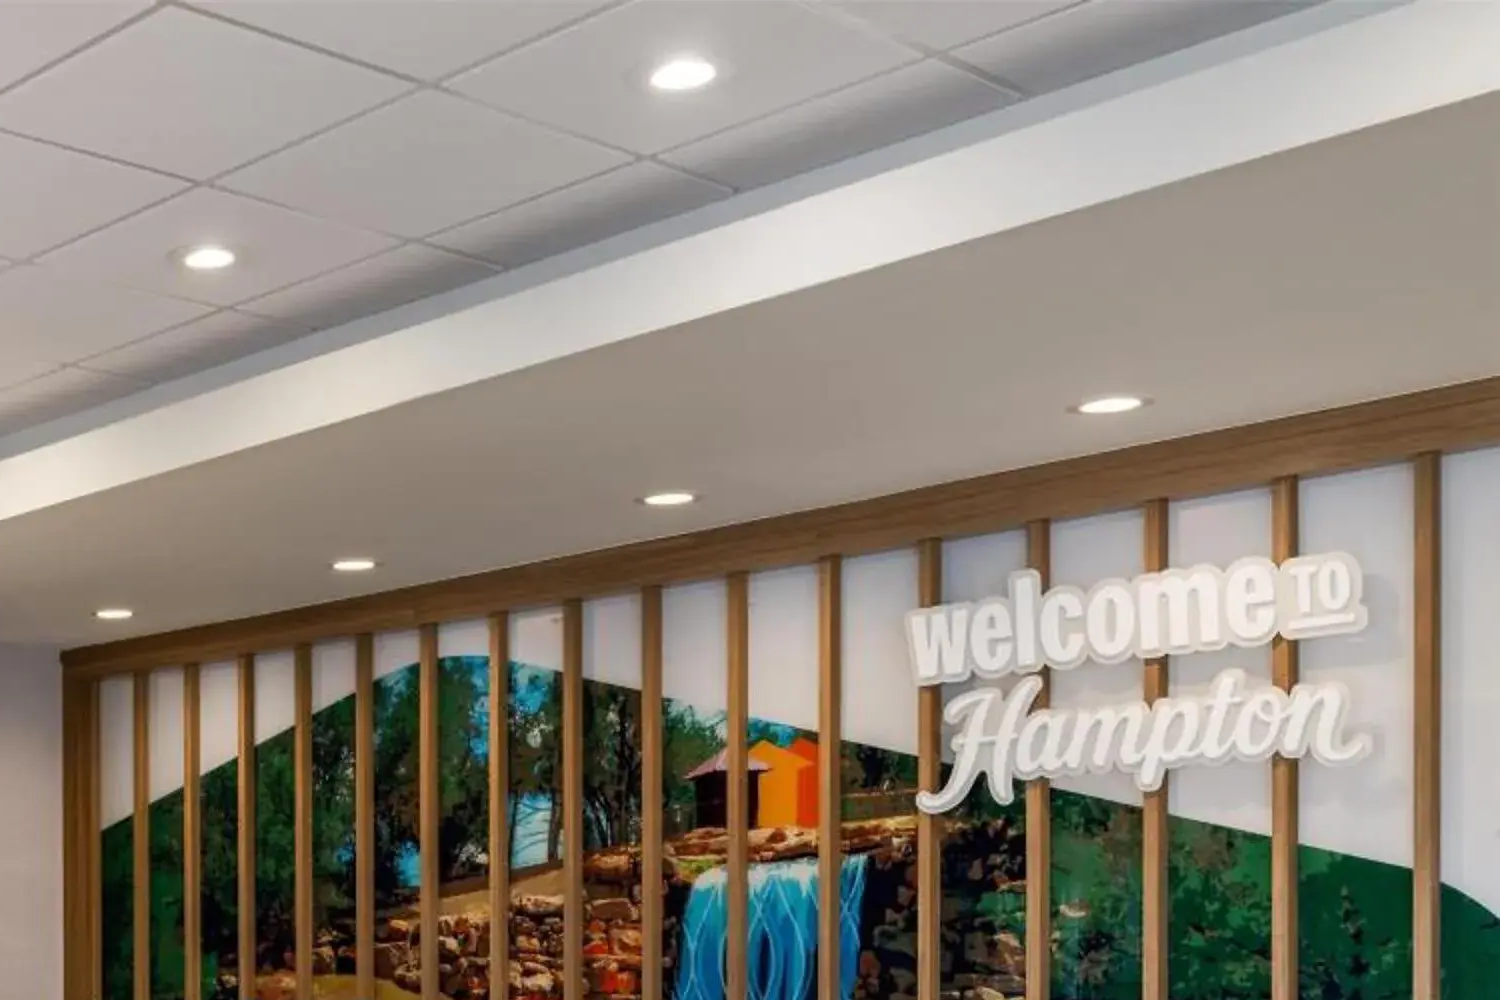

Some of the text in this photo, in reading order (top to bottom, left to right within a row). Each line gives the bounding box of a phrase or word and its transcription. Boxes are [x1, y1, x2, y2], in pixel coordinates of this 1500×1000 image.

[910, 558, 1355, 679] welcome TO
[917, 671, 1368, 812] Hampton
